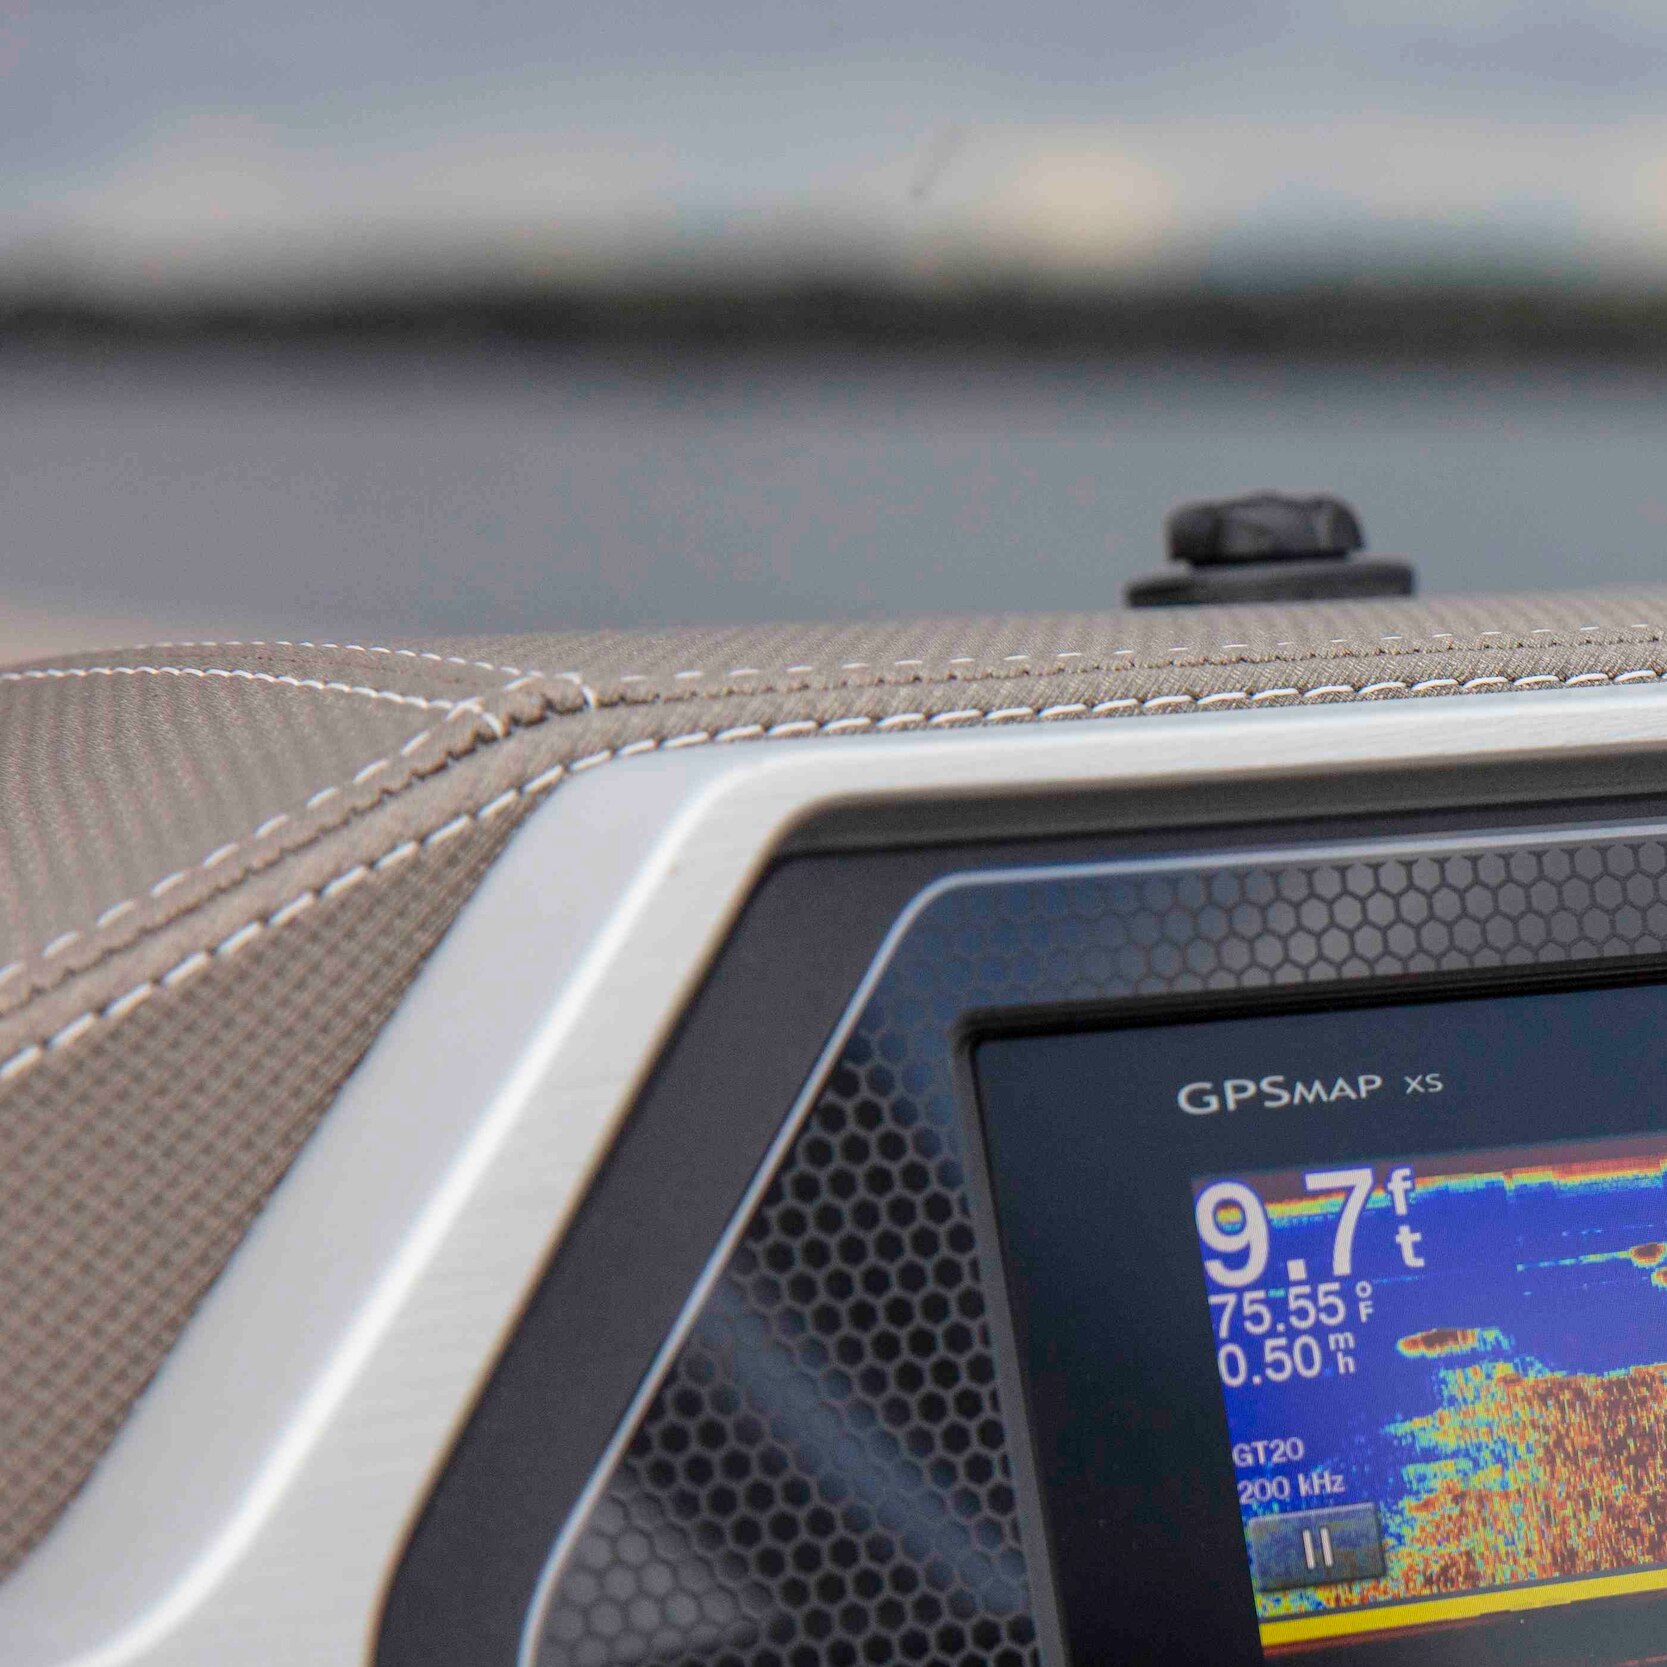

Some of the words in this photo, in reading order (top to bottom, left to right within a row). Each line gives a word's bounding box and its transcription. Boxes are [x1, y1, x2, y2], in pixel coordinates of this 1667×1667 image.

[1194, 1168, 1374, 1287] 9.7
[1208, 1282, 1346, 1339] 75.55
[1218, 1335, 1322, 1388] 0.50
[1232, 1436, 1305, 1468] GT20
[1237, 1474, 1291, 1505] 200
[1297, 1470, 1346, 1497] kHz
